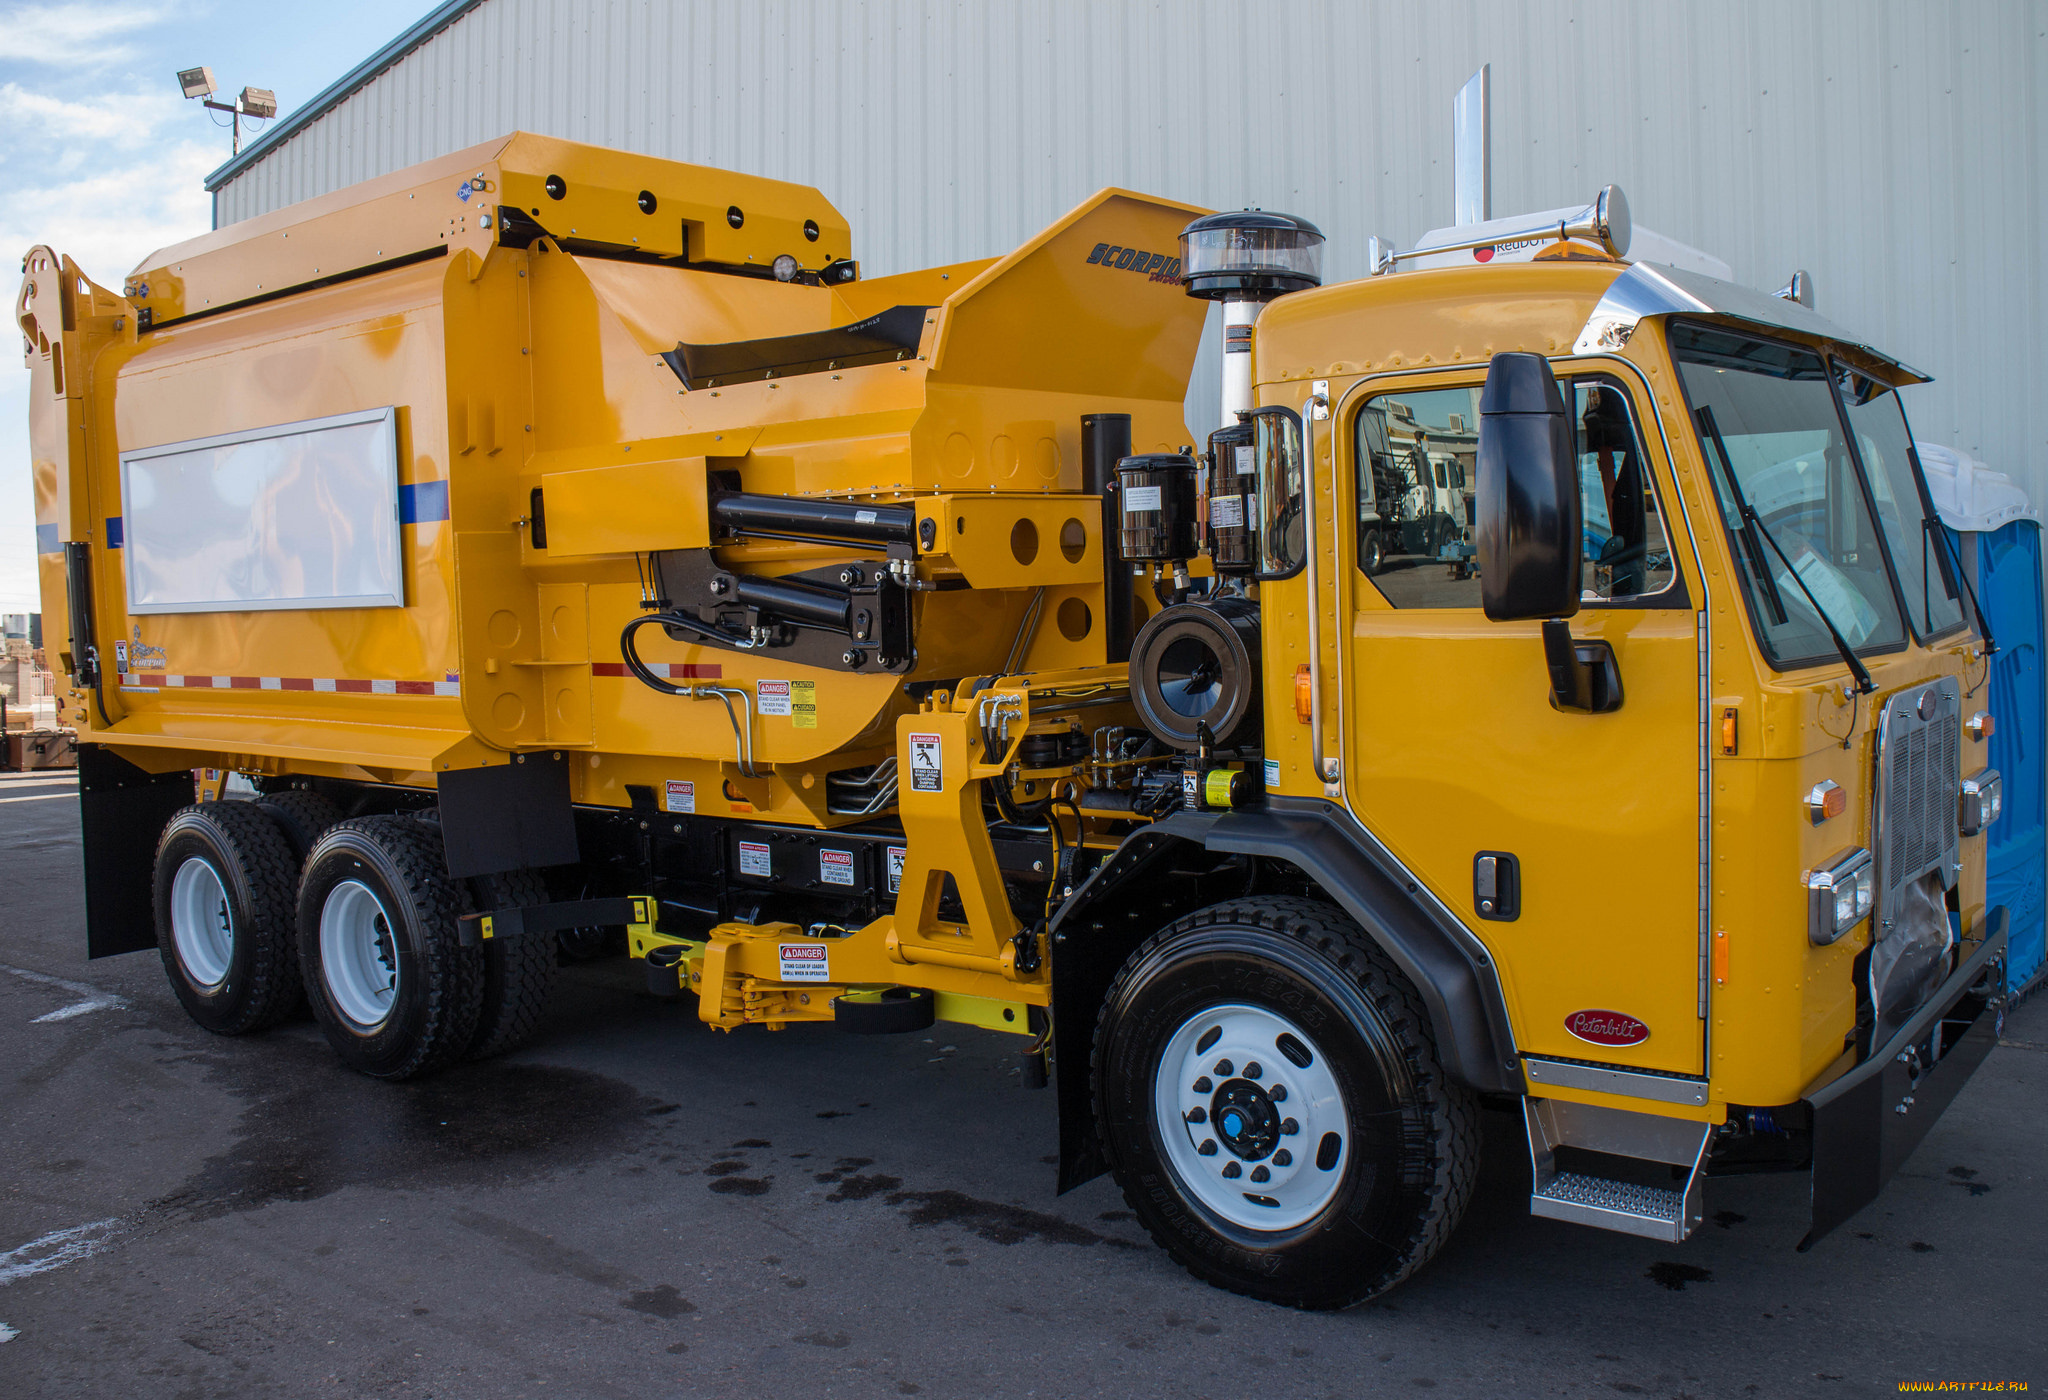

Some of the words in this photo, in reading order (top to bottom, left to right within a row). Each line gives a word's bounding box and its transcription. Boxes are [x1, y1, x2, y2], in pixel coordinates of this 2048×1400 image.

[459, 187, 471, 197] CNG
[1086, 243, 1181, 277] SCORPIO
[765, 684, 787, 693] DANGER
[673, 785, 691, 793] DANGER
[828, 854, 850, 863] DANGER
[792, 949, 822, 958] DANGER
[1573, 1013, 1642, 1038] Peterbilt
